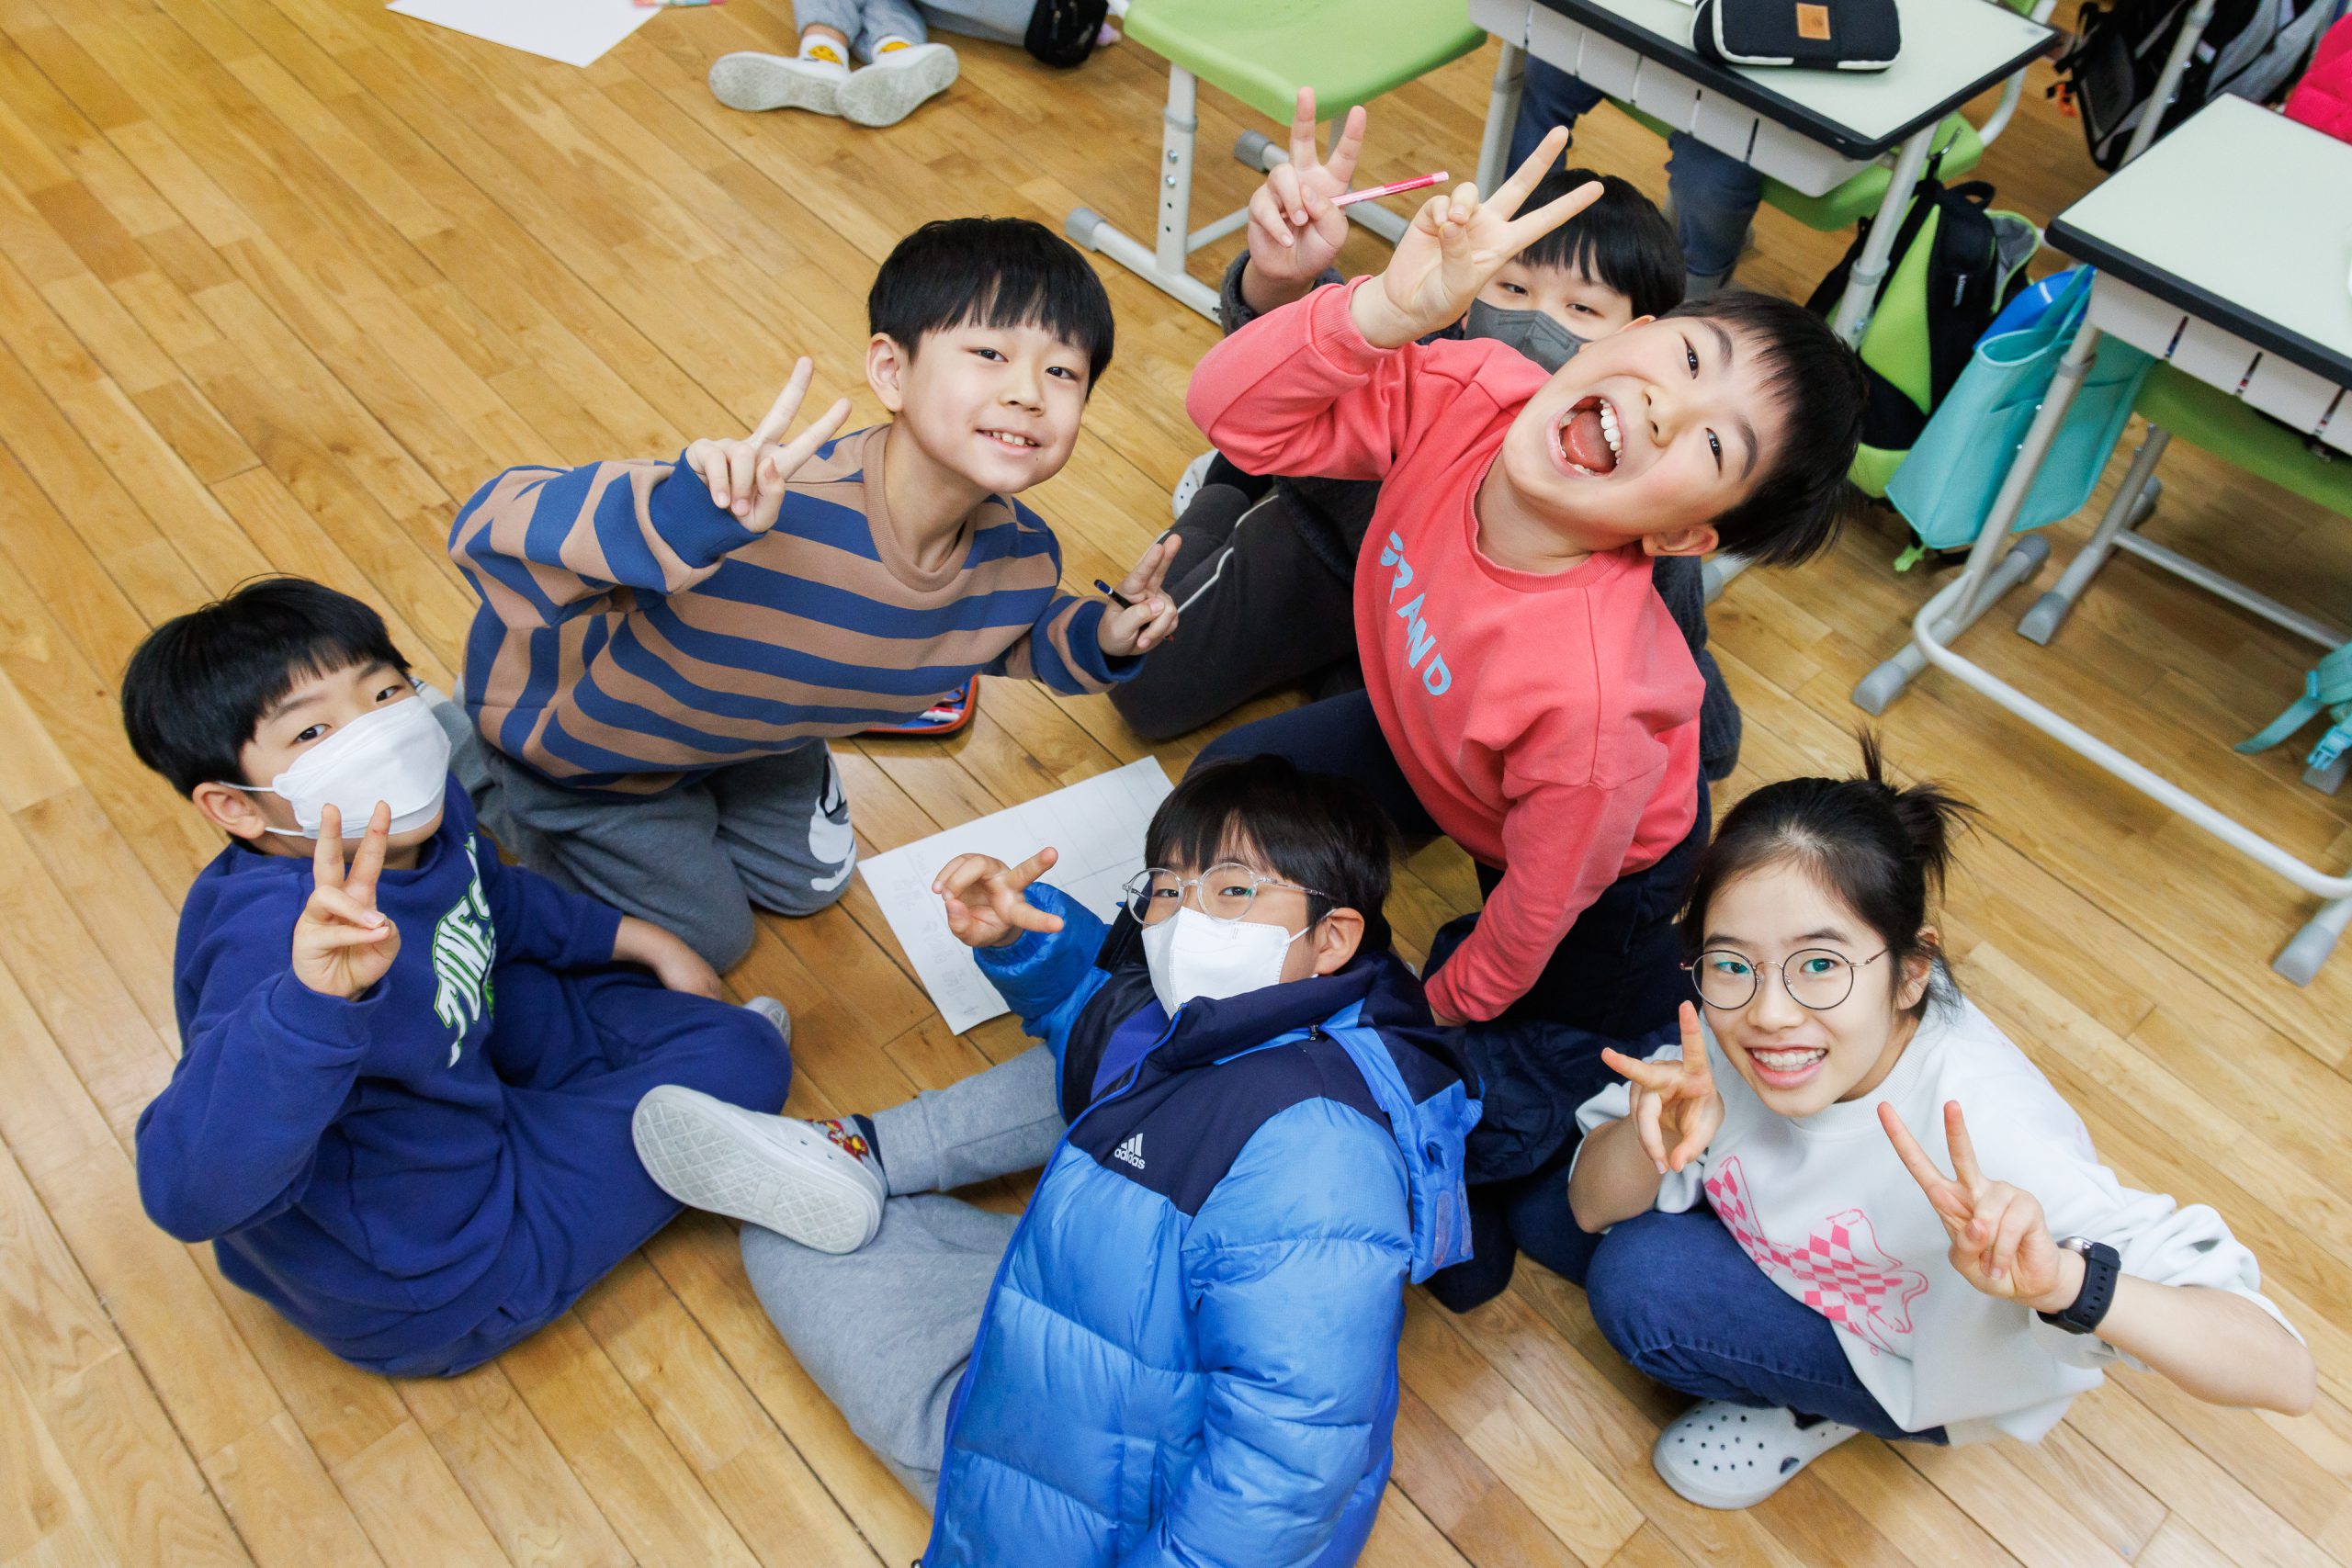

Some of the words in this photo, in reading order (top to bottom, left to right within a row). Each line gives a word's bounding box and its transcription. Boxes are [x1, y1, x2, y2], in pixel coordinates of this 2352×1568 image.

[1379, 530, 1453, 696] GRAND
[433, 896, 492, 1067] TUNE
[1114, 1147, 1146, 1169] adidas
